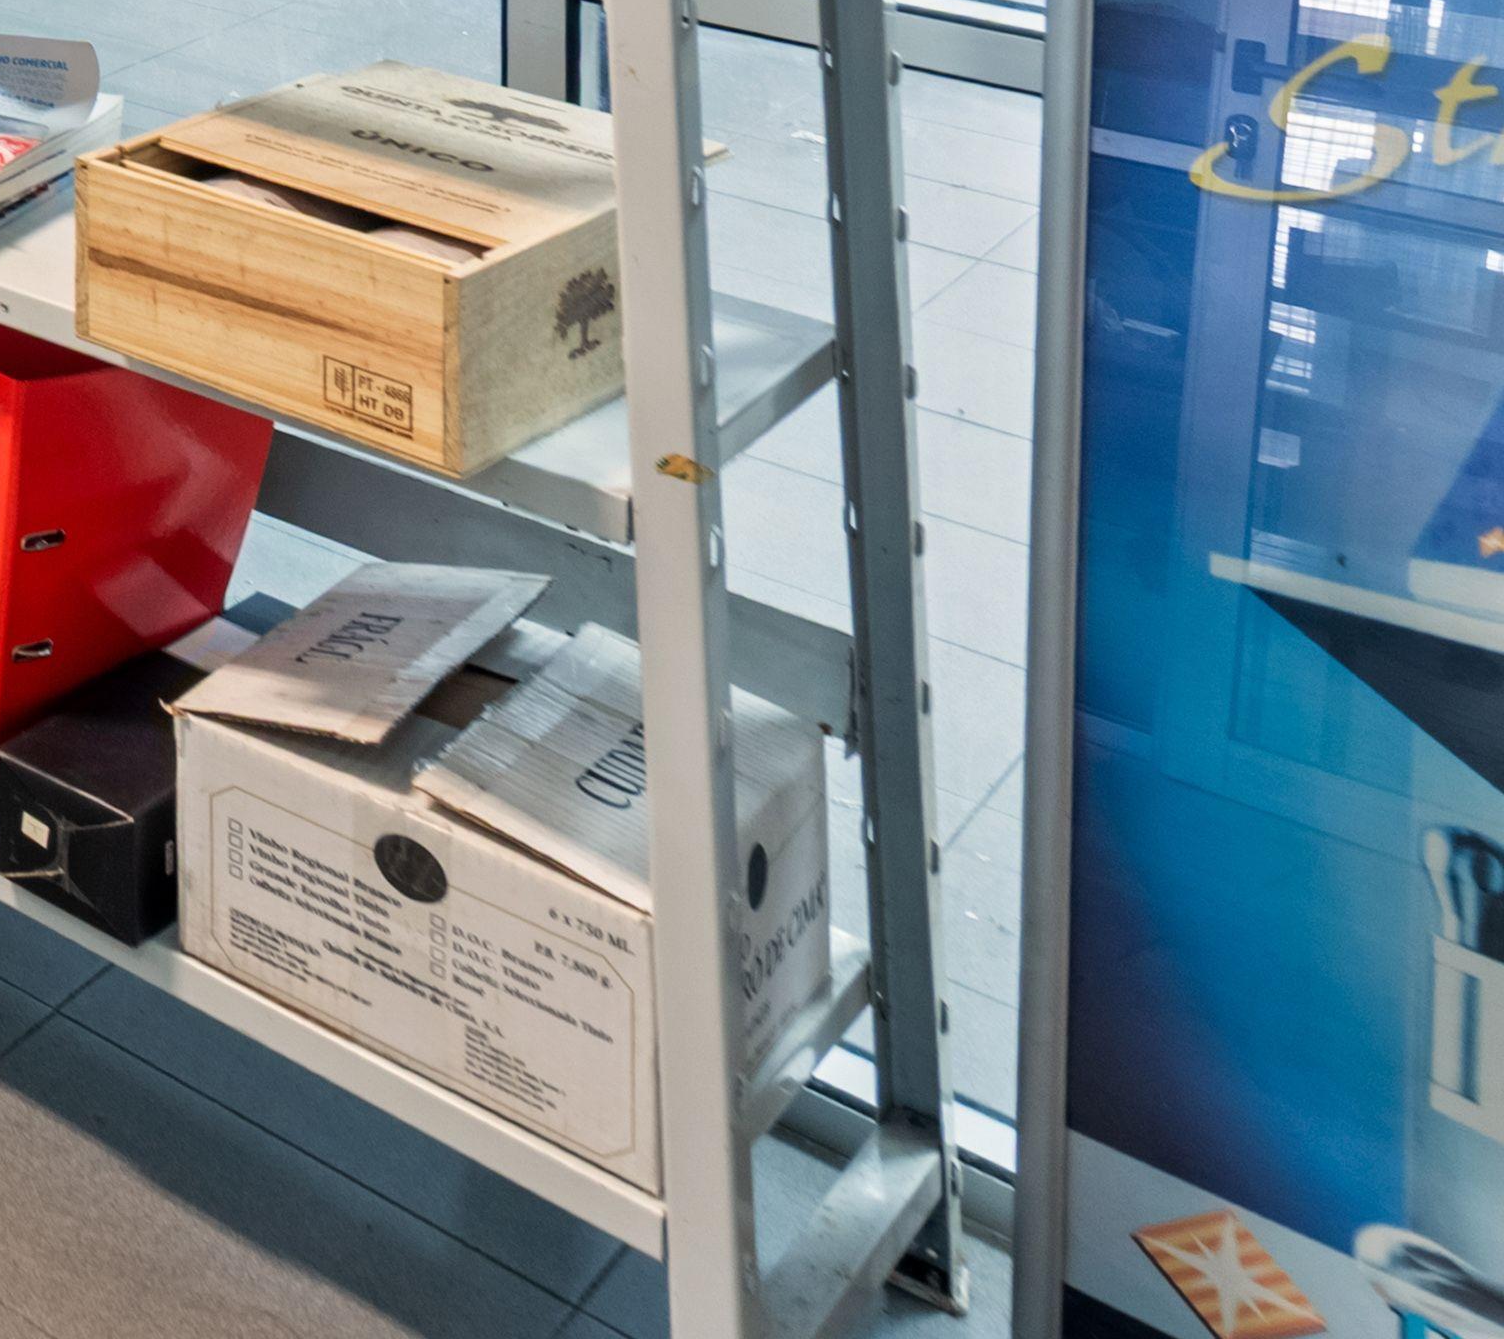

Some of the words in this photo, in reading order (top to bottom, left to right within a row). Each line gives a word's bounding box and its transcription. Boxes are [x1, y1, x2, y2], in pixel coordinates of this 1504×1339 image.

[12, 56, 69, 71] COMERCIAL
[340, 85, 443, 117] QUINTA
[1189, 33, 1504, 203] St
[351, 128, 494, 174] ÚNICO
[359, 394, 378, 410] HT
[249, 827, 288, 853] Vinho
[292, 847, 349, 882] Regional
[353, 876, 402, 908] Branco
[249, 843, 288, 870] Vinho
[292, 864, 349, 898] Regional
[353, 892, 390, 918] Tinto
[576, 918, 604, 941] 750
[501, 948, 555, 981] Branco
[503, 965, 541, 991] Tinto
